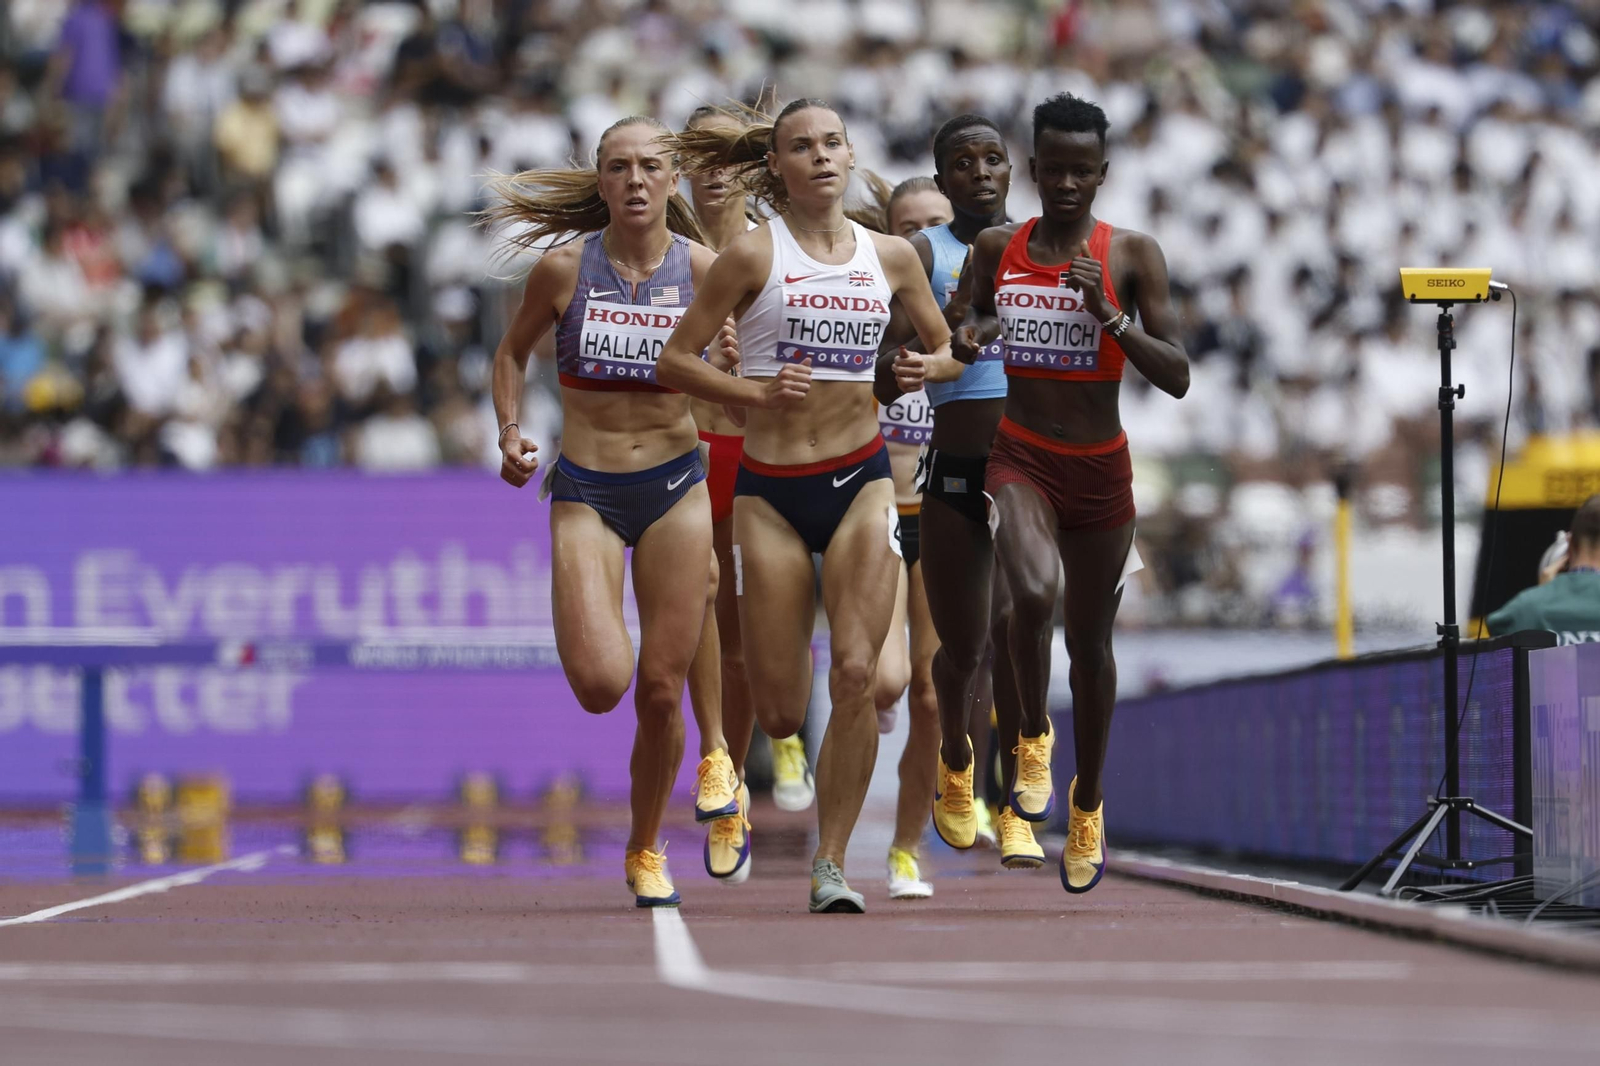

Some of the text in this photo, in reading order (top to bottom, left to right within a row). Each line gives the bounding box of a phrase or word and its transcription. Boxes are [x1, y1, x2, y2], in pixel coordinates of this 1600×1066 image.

[1427, 279, 1466, 288] SEIKO
[786, 294, 889, 314] HONDA
[787, 318, 881, 346] THORNER
[1001, 317, 1096, 347] CHEROTICH
